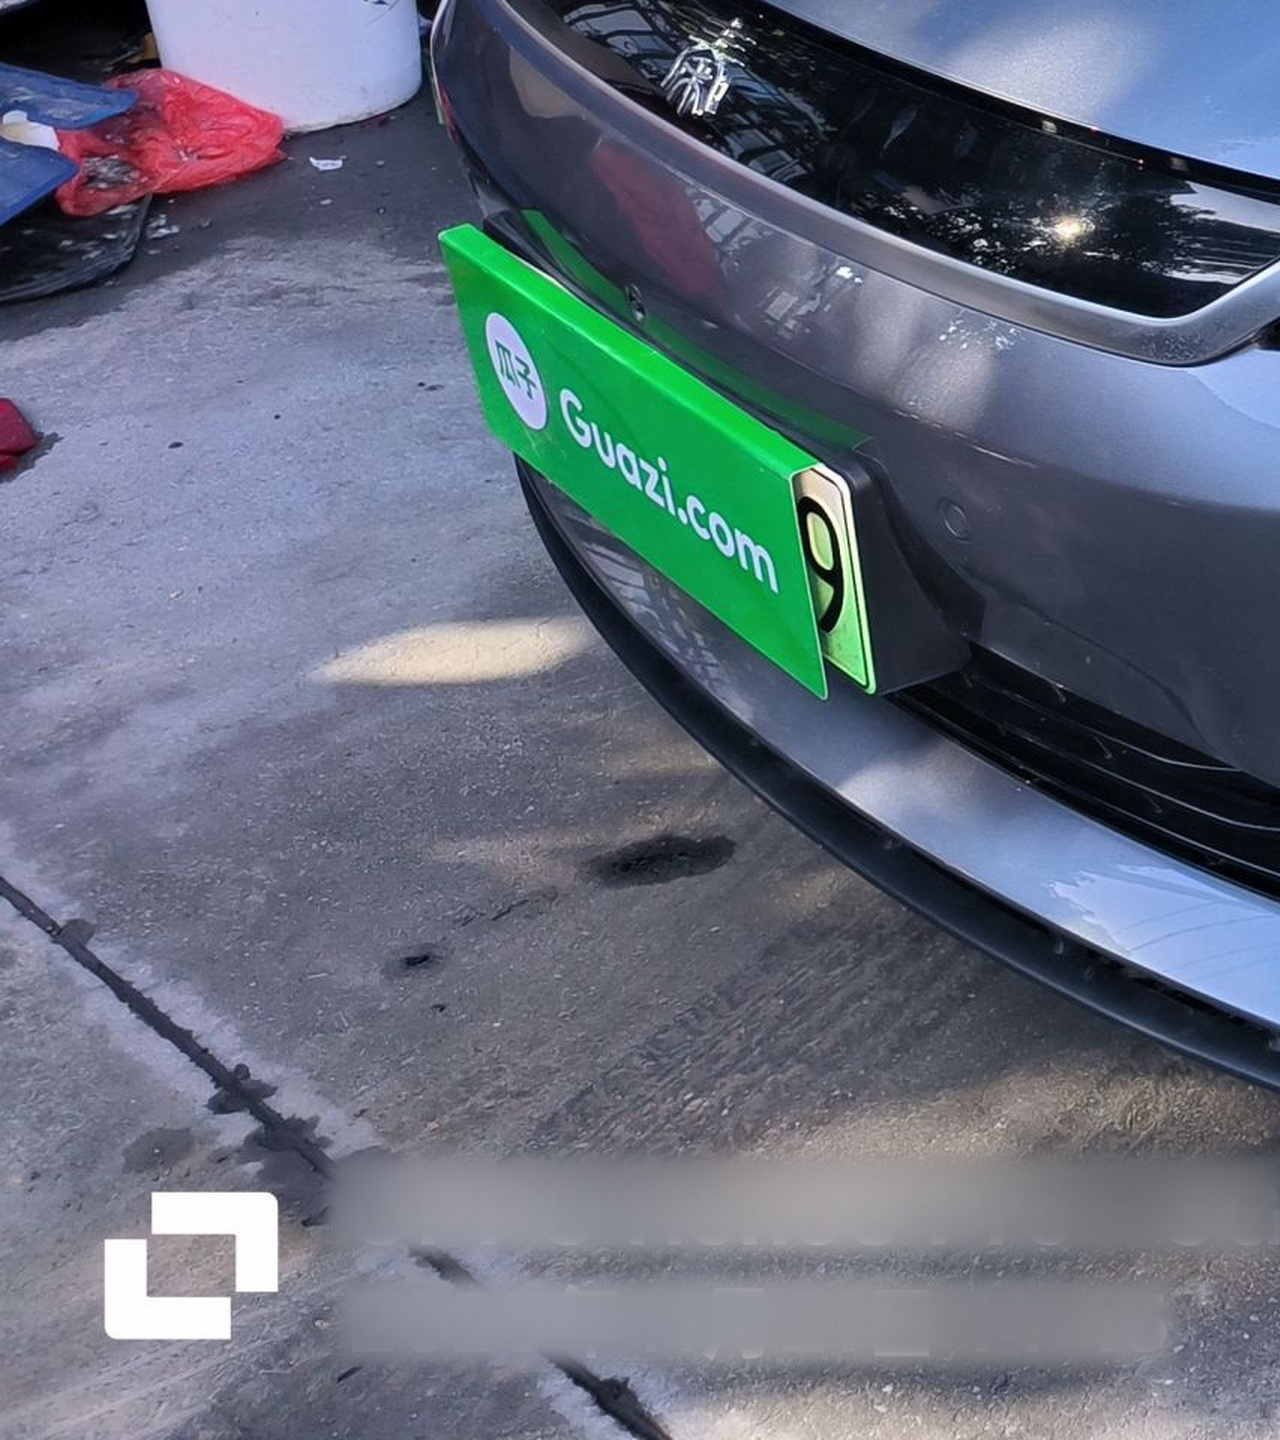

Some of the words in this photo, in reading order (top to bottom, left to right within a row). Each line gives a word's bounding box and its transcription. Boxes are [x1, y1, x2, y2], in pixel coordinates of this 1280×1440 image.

[495, 339, 538, 400] 瓜子
[560, 389, 779, 595] Guazi.com
[797, 496, 844, 634] 9
